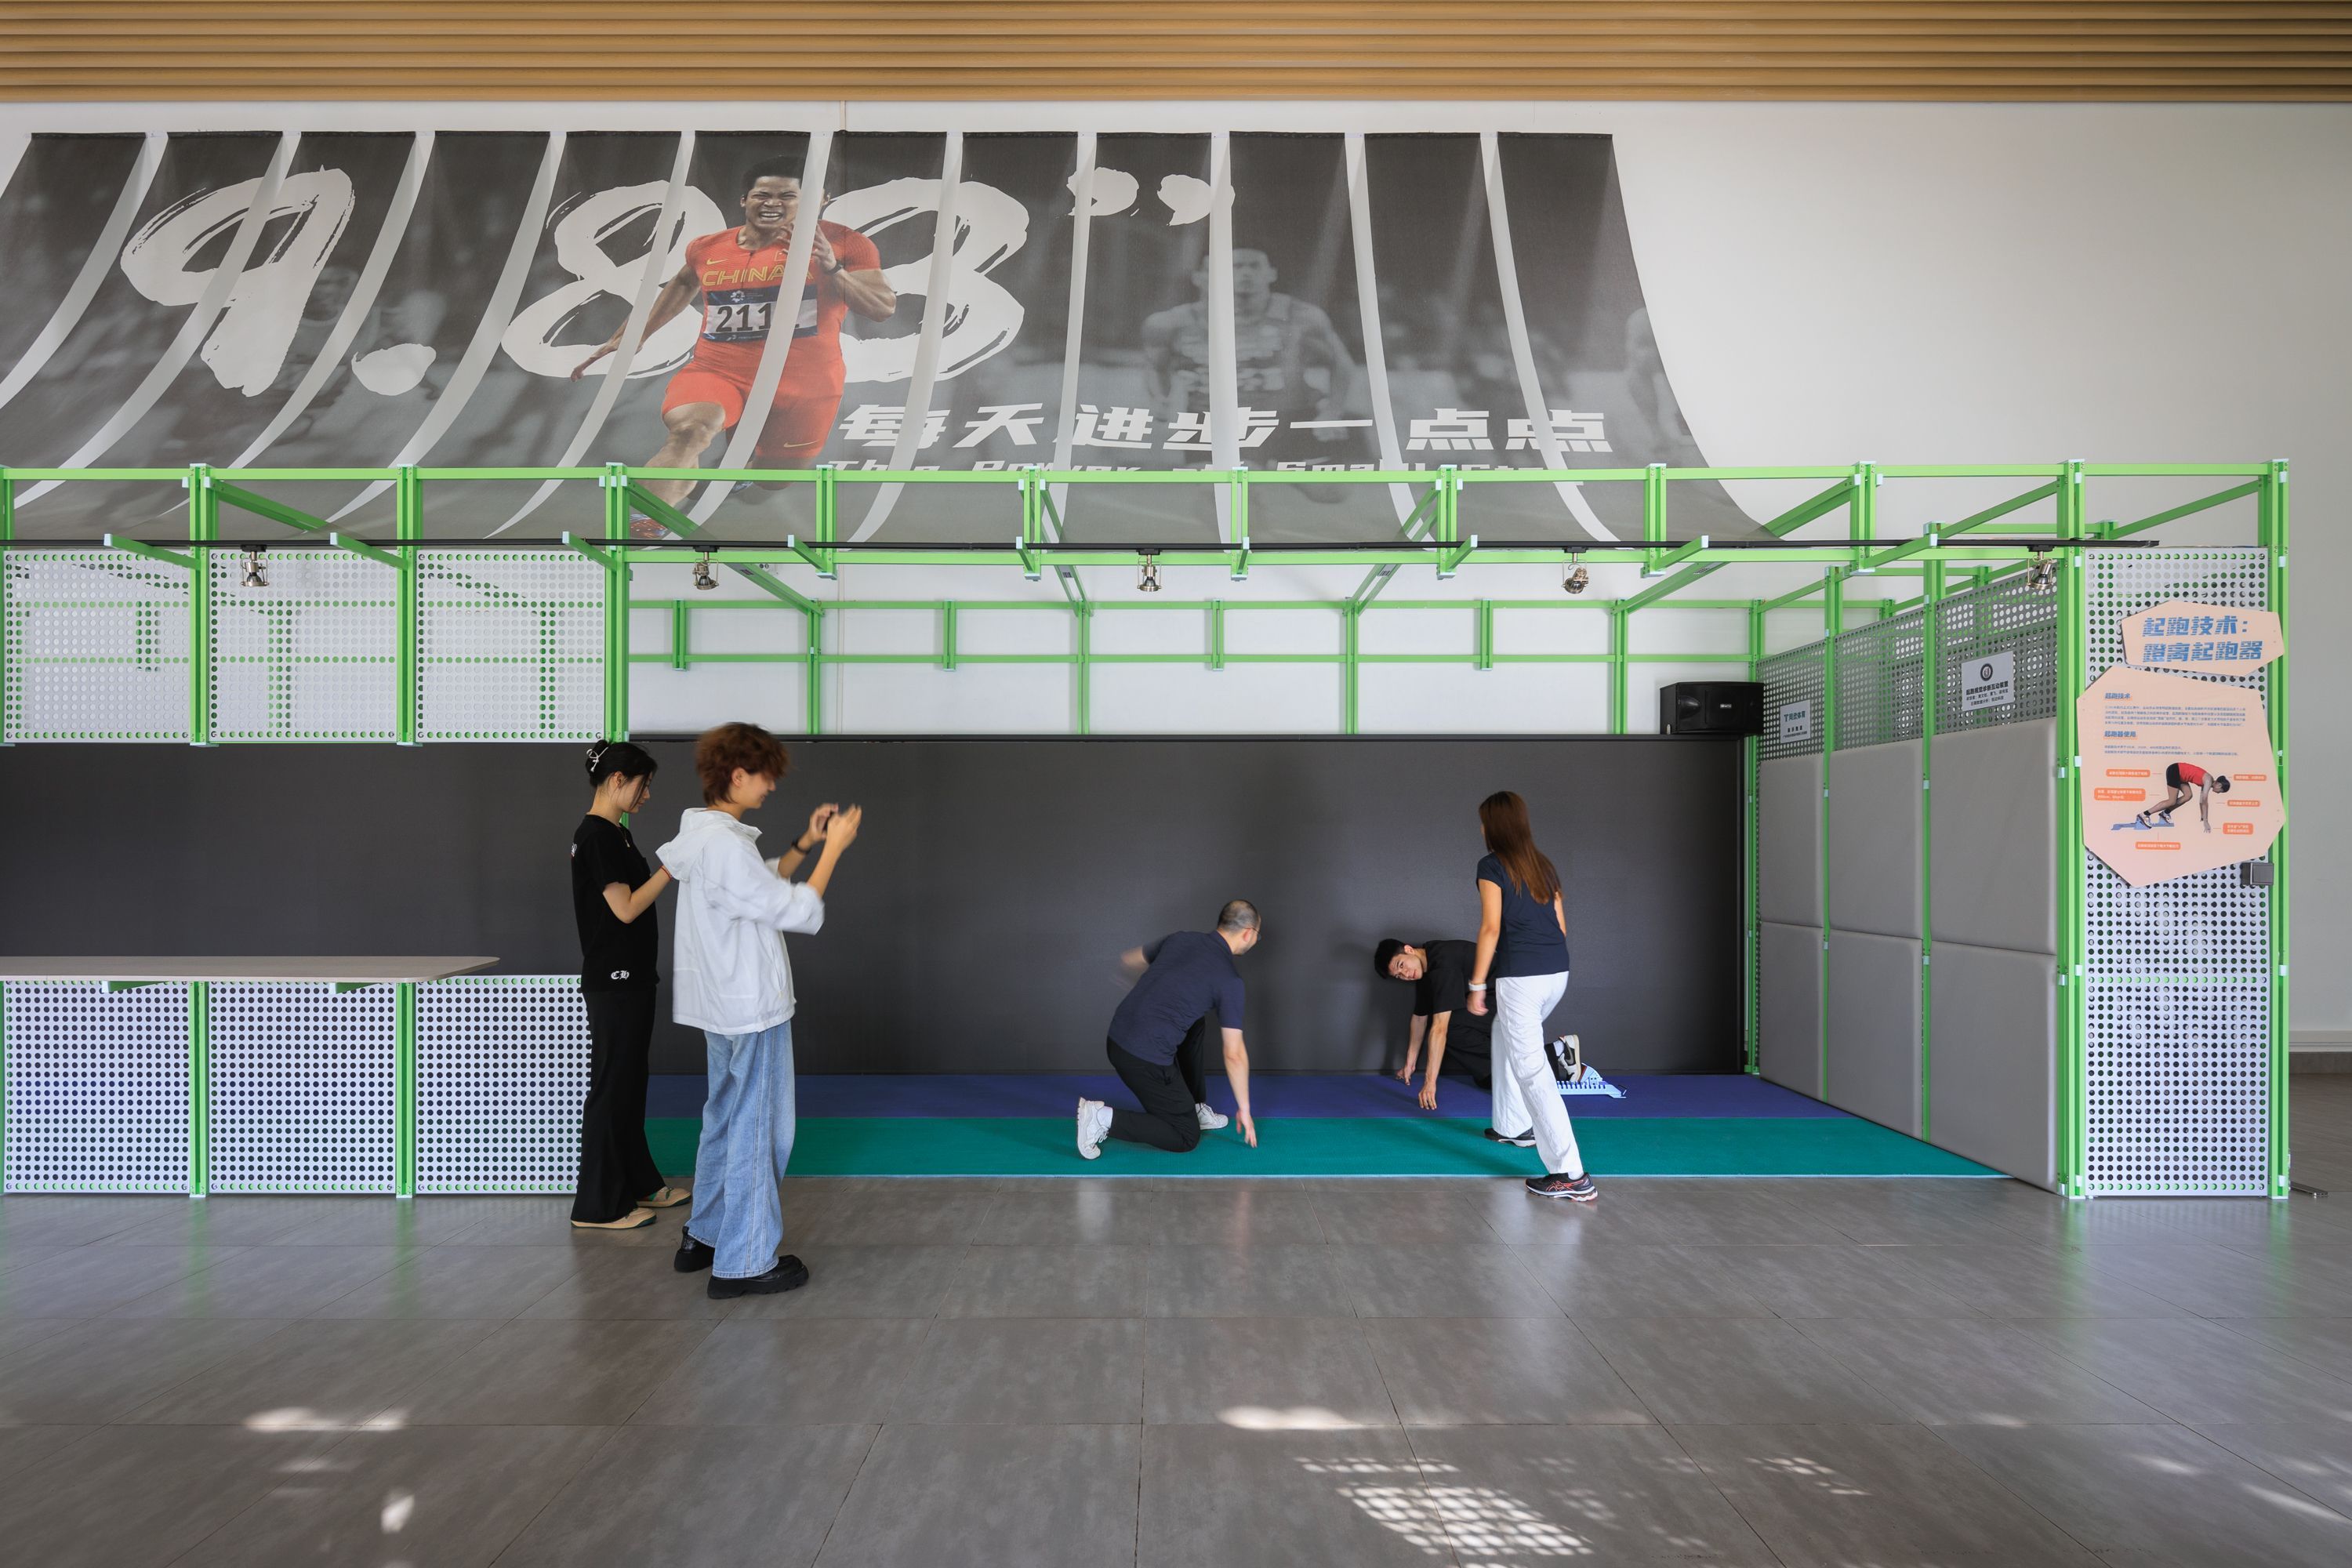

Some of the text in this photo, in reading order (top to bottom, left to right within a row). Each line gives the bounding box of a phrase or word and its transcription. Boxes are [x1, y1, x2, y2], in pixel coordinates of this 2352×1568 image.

[702, 264, 815, 287] CHINA
[838, 402, 1613, 452] 每天进步一点点
